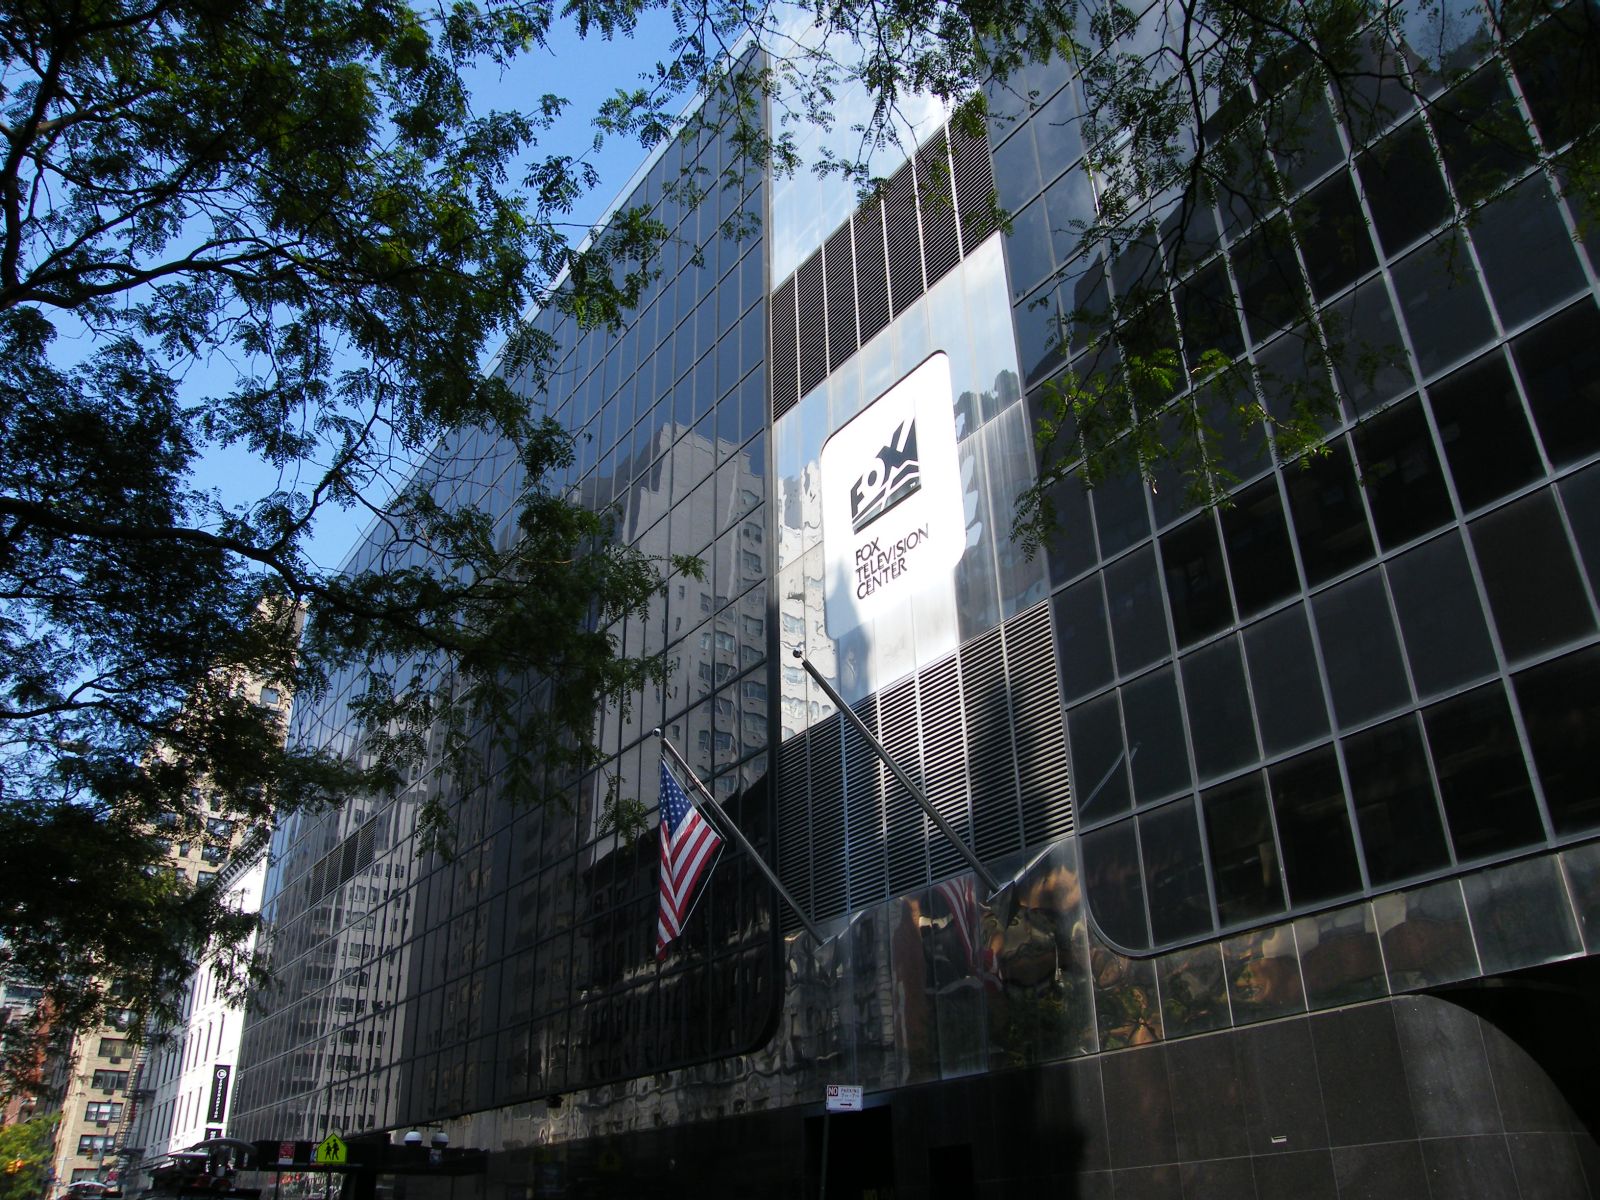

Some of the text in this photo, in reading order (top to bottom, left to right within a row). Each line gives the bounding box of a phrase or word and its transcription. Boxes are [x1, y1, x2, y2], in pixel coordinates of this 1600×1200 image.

[850, 417, 920, 522] FOX
[855, 537, 881, 566] FOX
[855, 523, 929, 583] TELEVISION
[856, 557, 907, 600] CENTER
[828, 1086, 838, 1096] NO
